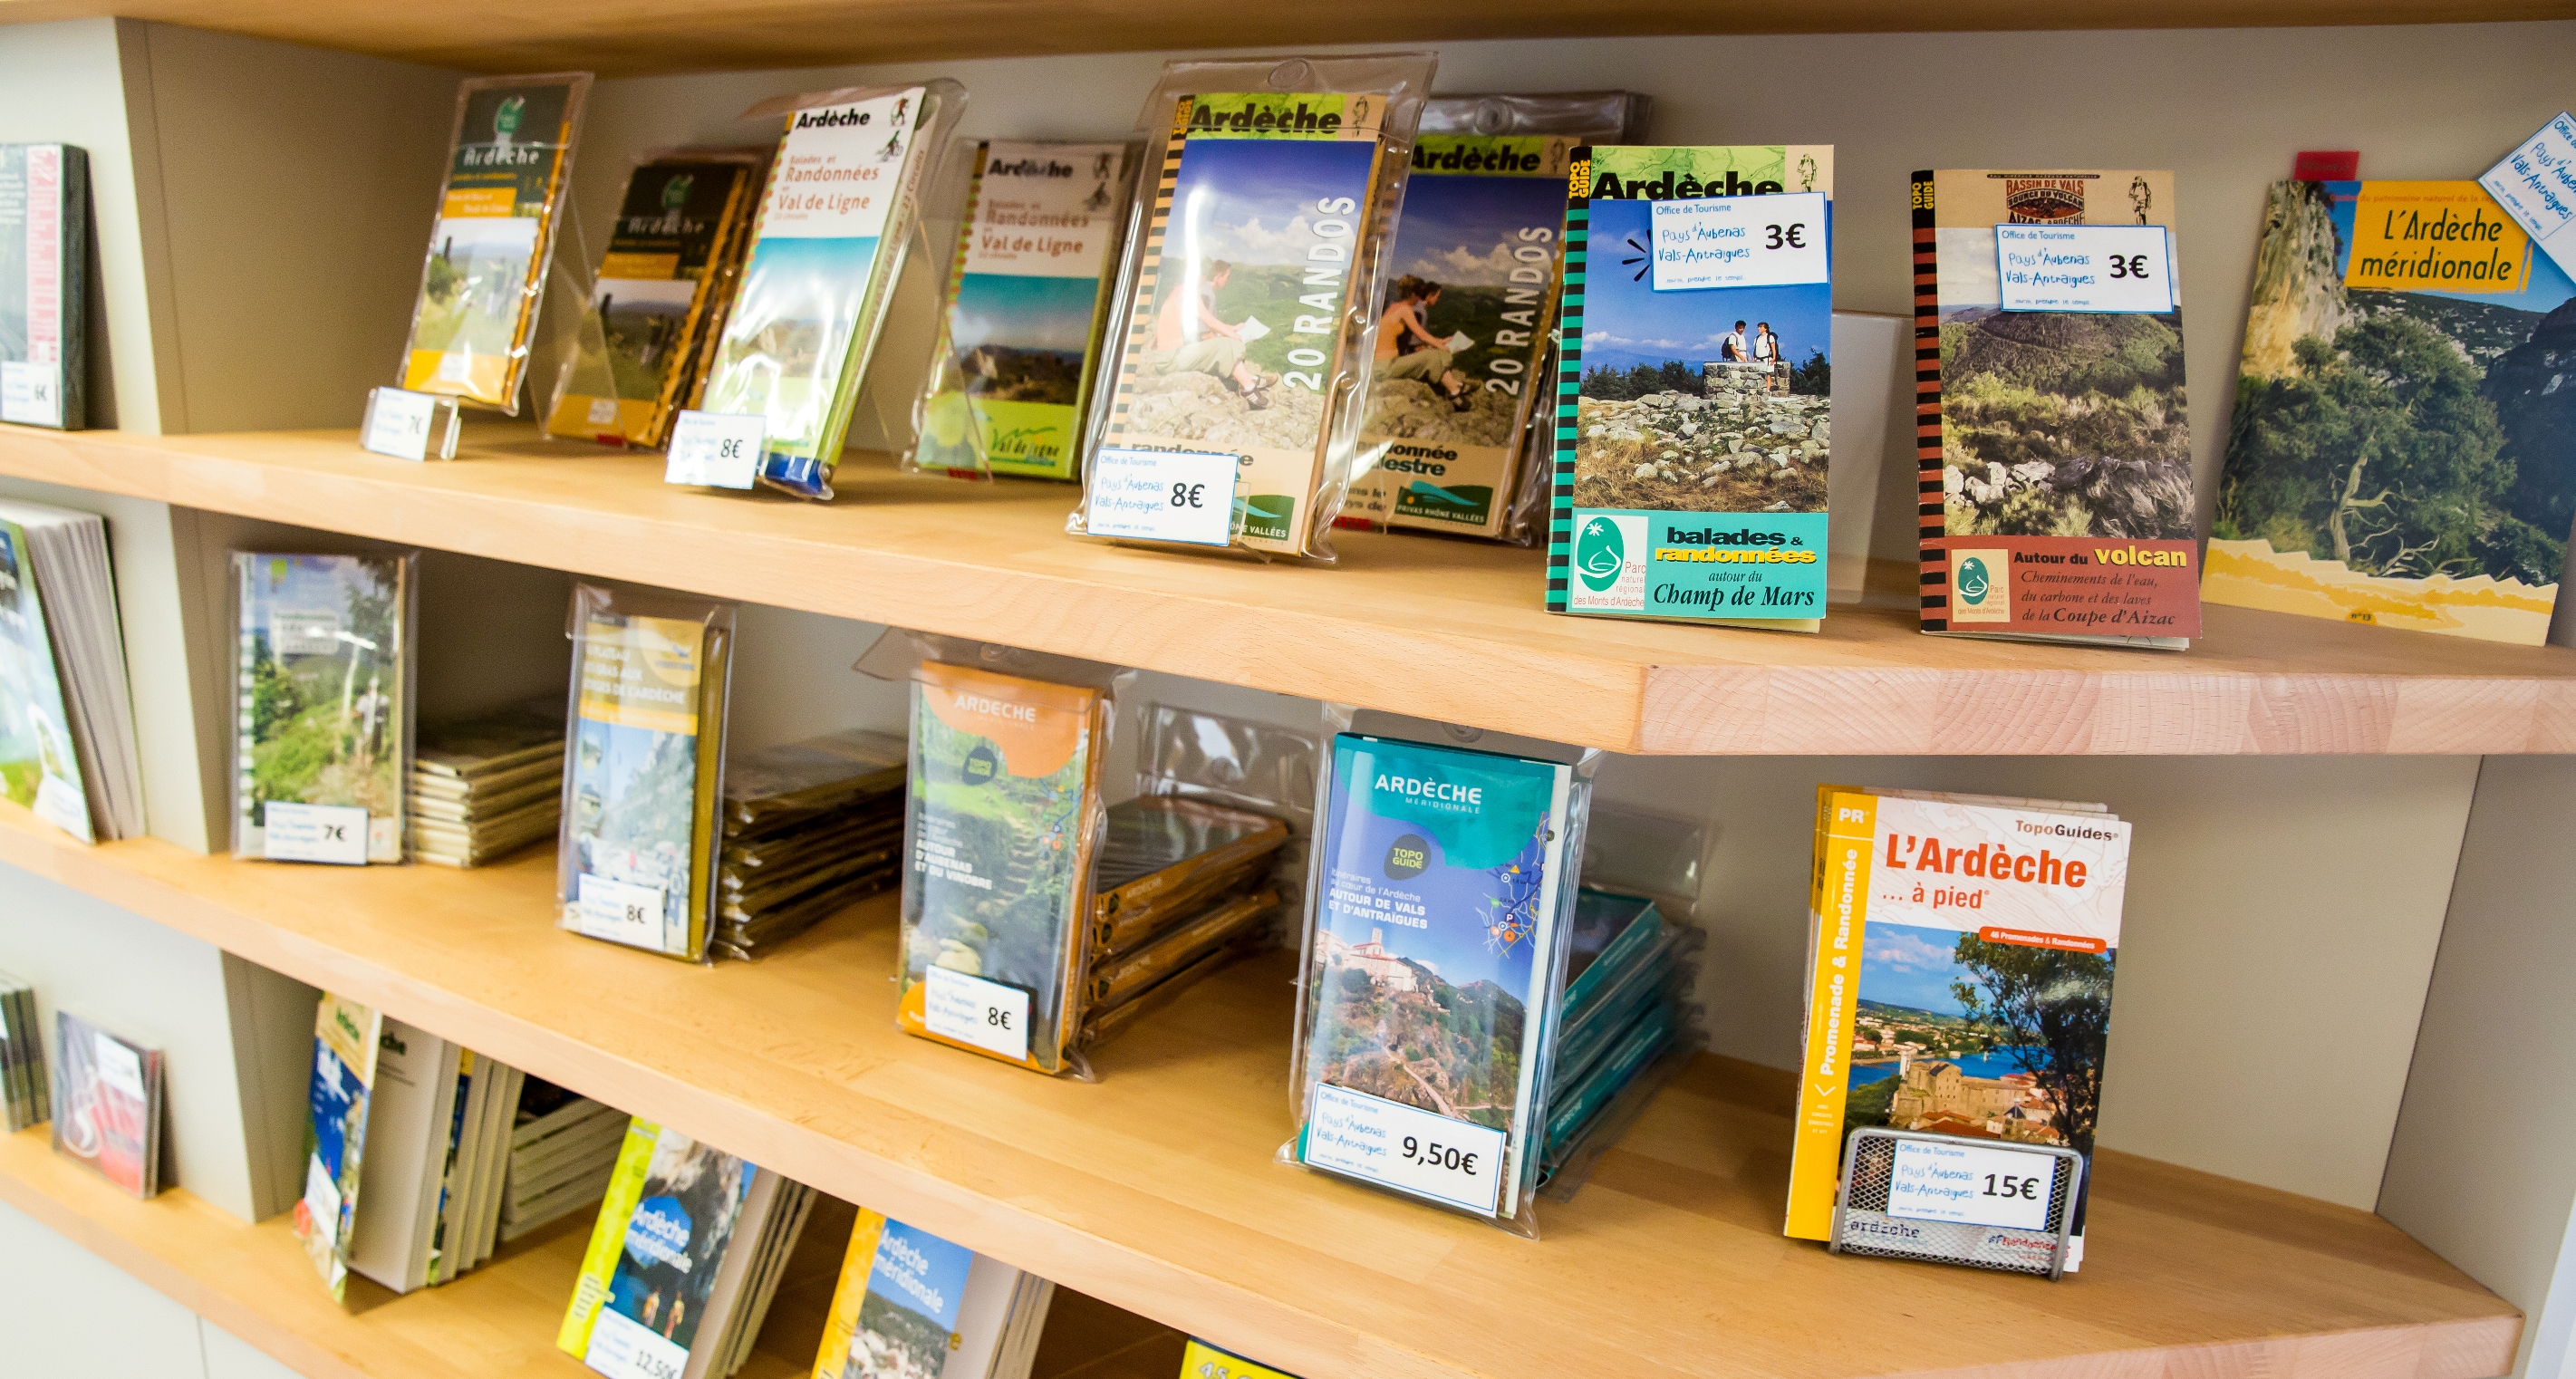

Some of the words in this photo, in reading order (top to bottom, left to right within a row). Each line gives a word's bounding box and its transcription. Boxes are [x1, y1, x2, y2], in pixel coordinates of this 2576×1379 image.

[796, 108, 871, 130] Ardèche
[1187, 101, 1342, 133] Ardèche
[2554, 121, 2572, 141] Office
[1412, 144, 1540, 171] Ardèche
[2530, 141, 2555, 167] Pays
[785, 164, 879, 182] Randonnées
[1568, 162, 1580, 198] TOPO
[1578, 159, 1590, 198] GUIDE
[1590, 170, 1784, 200] Ardèche
[1912, 182, 1923, 209] TOPO
[1924, 180, 1934, 209] GUIDE
[2006, 179, 2042, 197] BASSIN
[2044, 180, 2056, 188] DE
[2059, 180, 2084, 197] VALS
[777, 193, 801, 210] Val
[806, 194, 824, 209] de
[828, 193, 870, 215] Ligne
[1656, 206, 1681, 216] Office
[1683, 205, 1693, 214] de
[1694, 204, 1732, 213] Tourisme
[2008, 190, 2039, 207] SOURCE
[2053, 192, 2084, 208] VOLCAN
[1663, 229, 1691, 243] Pays
[1692, 222, 1746, 241] d'Aubenas
[2002, 230, 2025, 239] Office
[2028, 230, 2038, 239] de
[2039, 230, 2075, 240] Tourisme
[2384, 207, 2503, 242] L'Ardèche
[981, 235, 1008, 251] Val
[1012, 236, 1033, 253] de
[1037, 237, 1084, 258] Ligne
[1765, 223, 1806, 250] 3€
[1293, 197, 1356, 335] RANDOS
[2009, 253, 2036, 266] Pays
[2038, 247, 2089, 266] d'Aubenas
[2108, 255, 2149, 279] 3€
[2360, 246, 2512, 281] méridionale
[1495, 227, 1553, 347] RANDOS
[1282, 348, 1326, 391] 20
[1485, 358, 1524, 396] 20
[720, 439, 743, 458] 8€
[1014, 439, 1028, 454] de
[1101, 456, 1118, 465] Office
[1121, 457, 1128, 465] de
[1130, 457, 1157, 467] Tourisme
[1102, 477, 1122, 491] Pays
[1171, 482, 1205, 508] 8€
[1250, 526, 1287, 537] VALLÉES
[1667, 526, 1786, 545] balades
[1790, 536, 1803, 545] &
[1655, 545, 1817, 564] randonnées
[2013, 552, 2066, 565] Autour
[2069, 554, 2089, 565] du
[2094, 545, 2187, 568] volcan
[1625, 561, 1646, 574] Parc
[1708, 571, 1746, 583] autour
[1748, 571, 1762, 583] du
[1616, 584, 1645, 594] régional
[1621, 575, 1645, 583] naturel
[1990, 584, 2004, 593] Parc
[2021, 570, 2107, 586] Cheminements
[2110, 573, 2123, 586] de
[2127, 574, 2157, 589] l'eau,
[1574, 595, 1587, 605] des
[1587, 595, 1609, 606] Monts
[1610, 596, 1645, 607] d'Ardèche
[1654, 583, 1724, 611] Champ
[1732, 585, 1755, 606] de
[1761, 586, 1815, 606] Mars
[2021, 590, 2038, 603] du
[2040, 589, 2084, 604] carbone
[2088, 592, 2098, 604] et
[2101, 592, 2119, 605] des
[2123, 592, 2151, 606] laves
[2022, 609, 2036, 622] de
[2038, 608, 2050, 622] la
[2053, 609, 2107, 625] Coupe
[2110, 609, 2176, 626] d'Aizac
[1375, 774, 1482, 805] ARDÈCHE
[1405, 796, 1481, 815] MÉRIDIONALE
[1838, 807, 1865, 824] PR
[323, 825, 345, 842] 7€
[2015, 820, 2112, 842] TopoGuides
[1392, 856, 1423, 869] GUIDE
[1394, 847, 1423, 861] TOPO
[1886, 834, 2087, 888] L'Ardèche
[1329, 888, 1372, 906] AUTOUR
[1375, 897, 1391, 910] DE
[1395, 901, 1425, 916] VALS
[1342, 881, 1363, 892] cœur
[1365, 885, 1375, 895] de
[1378, 887, 1421, 903] l'Ardèche
[1834, 848, 1857, 950] Randonnée
[1912, 882, 1925, 903] à
[1934, 885, 1983, 910] pied
[1328, 900, 1341, 911] ET
[1343, 903, 1428, 930] D'ANTRAÏGUES
[2001, 931, 2044, 944] Promenades
[2052, 937, 2095, 950] Randonnées
[1832, 956, 1847, 969] &
[988, 1007, 1011, 1030] 8€
[1819, 973, 1845, 1076] Promenade
[1320, 1091, 1338, 1103] Office
[1341, 1096, 1349, 1105] de
[1350, 1099, 1378, 1114] Tourisme
[1322, 1112, 1343, 1128] Pays
[1402, 1136, 1478, 1176] 9,50€
[1900, 1143, 1920, 1153] Office
[1923, 1146, 1931, 1154] de
[1933, 1146, 1965, 1157] Tourisme
[1902, 1164, 1925, 1178] Pays
[1927, 1162, 1974, 1181] d'Aubenas
[1983, 1173, 2039, 1201] 15€
[632, 1202, 690, 1247] Ardèche
[879, 1229, 929, 1277] Ardèche
[873, 1252, 944, 1314] méridionale
